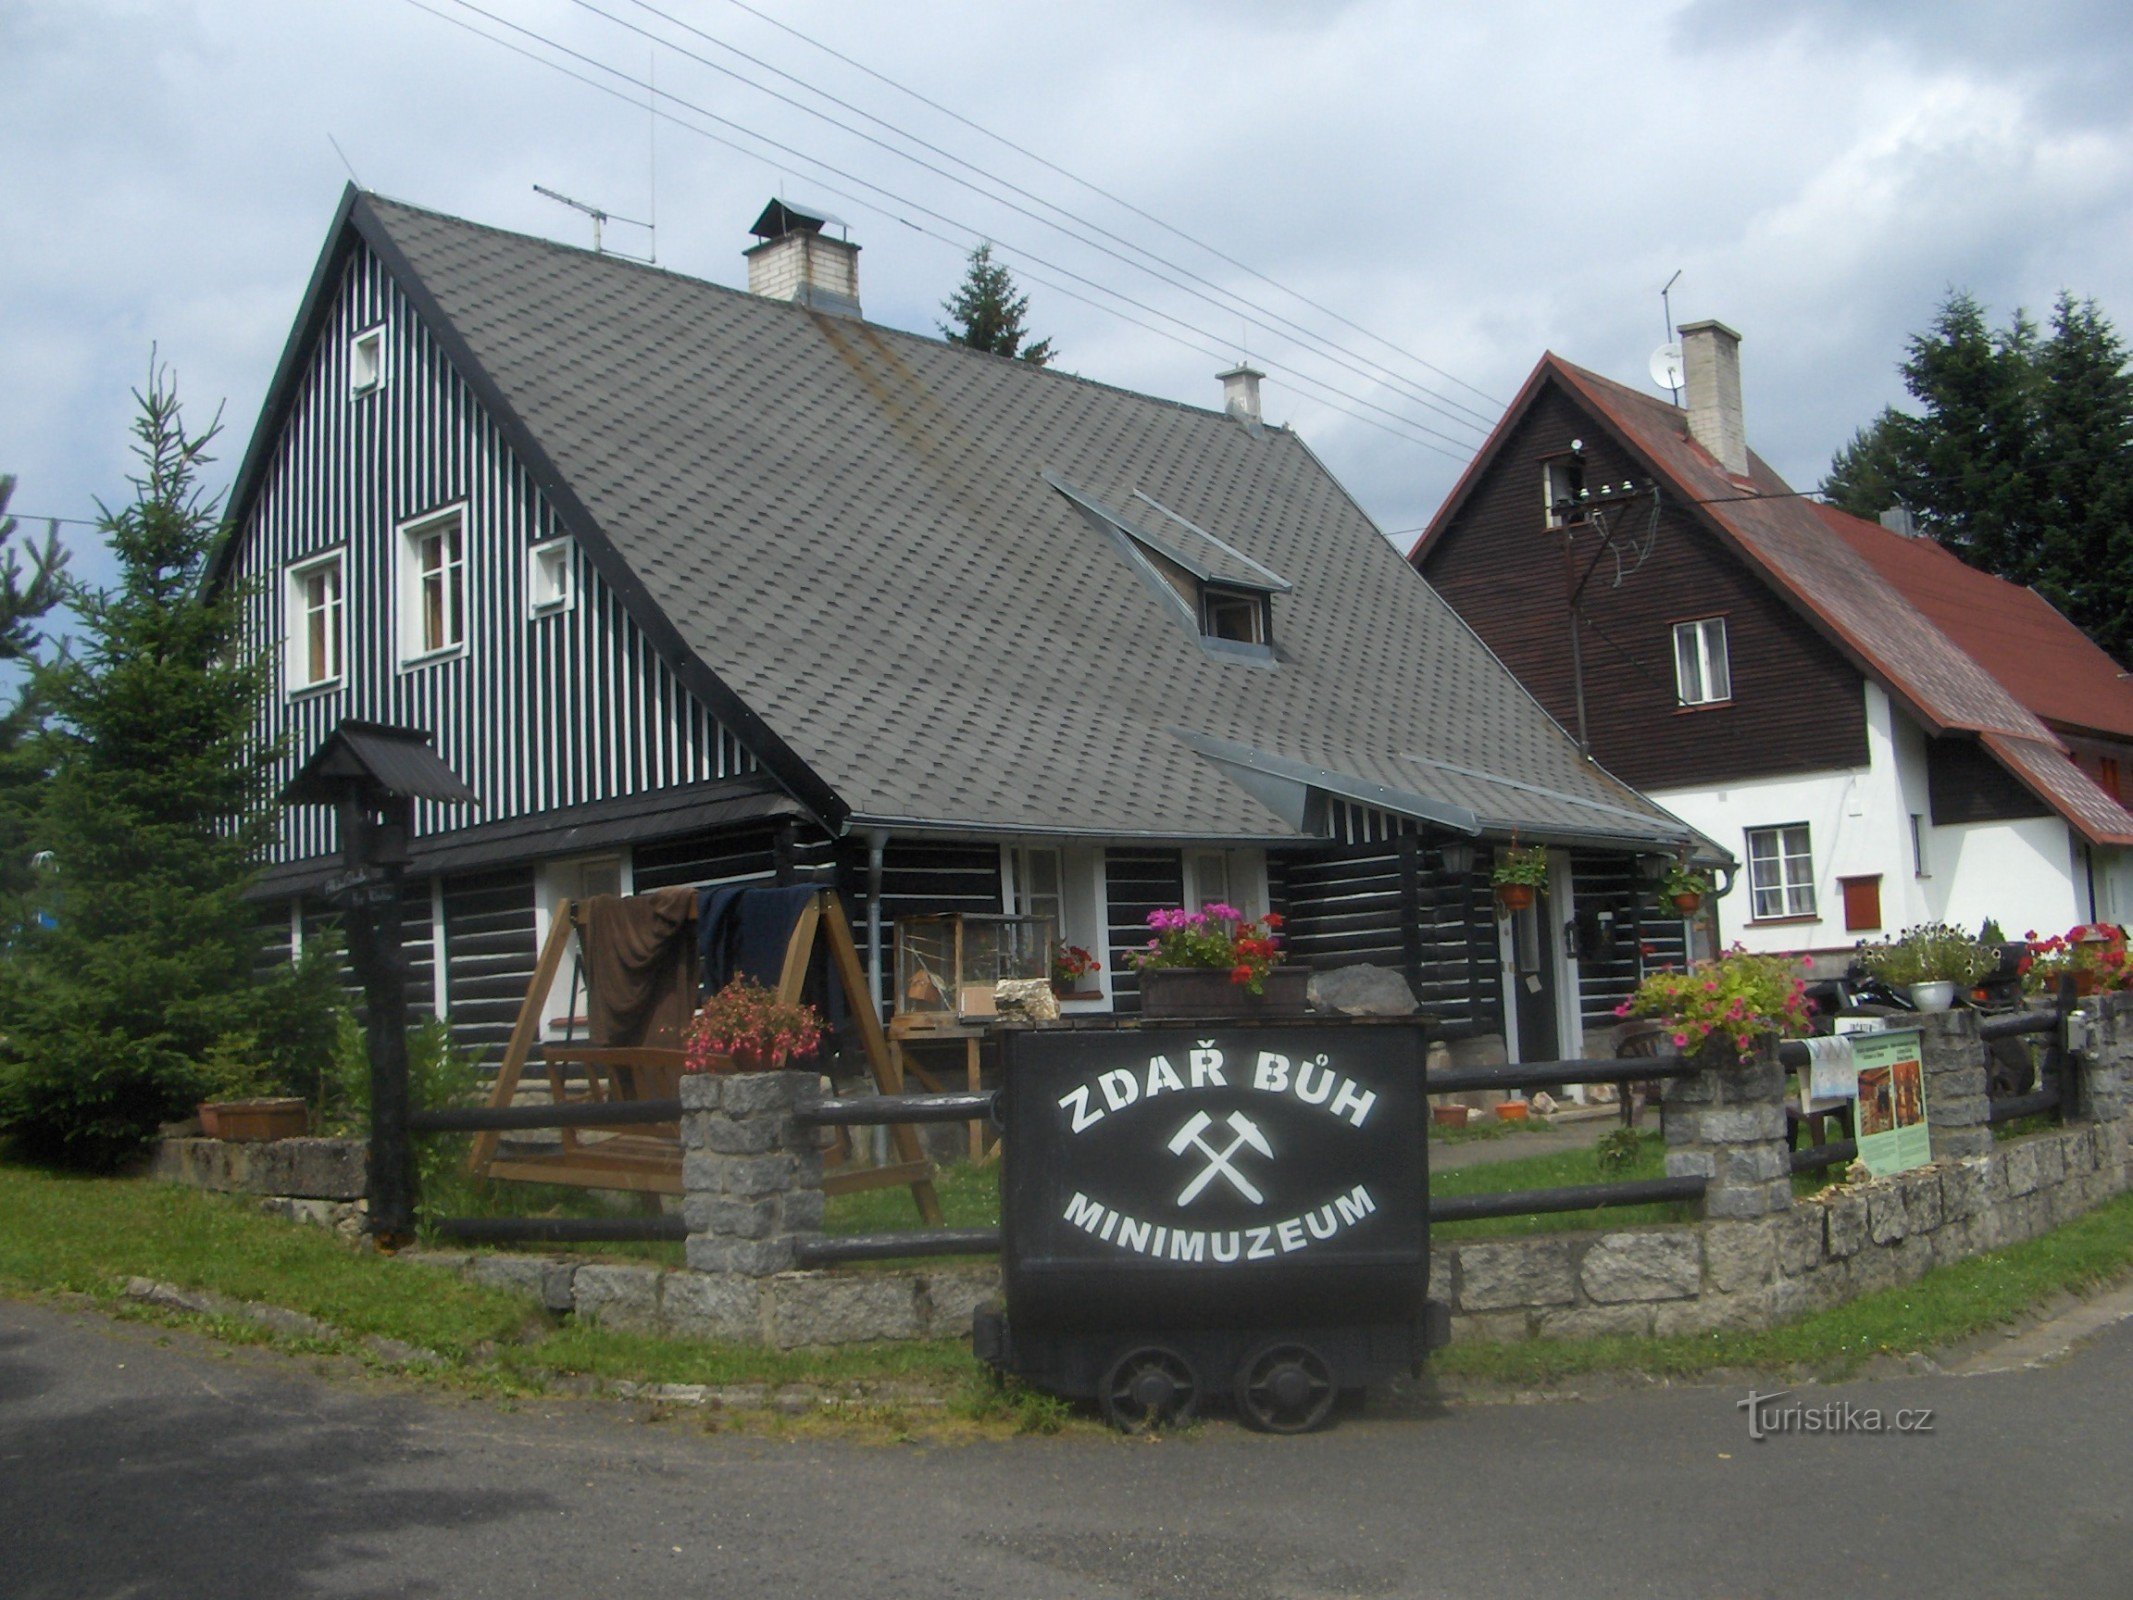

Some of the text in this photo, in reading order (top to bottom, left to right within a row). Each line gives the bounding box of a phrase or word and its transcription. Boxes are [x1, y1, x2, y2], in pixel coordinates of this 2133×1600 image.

[1058, 1039, 1377, 1134] ZDAŘ BŮH
[1063, 1184, 1377, 1262] MINIMUZEUM
